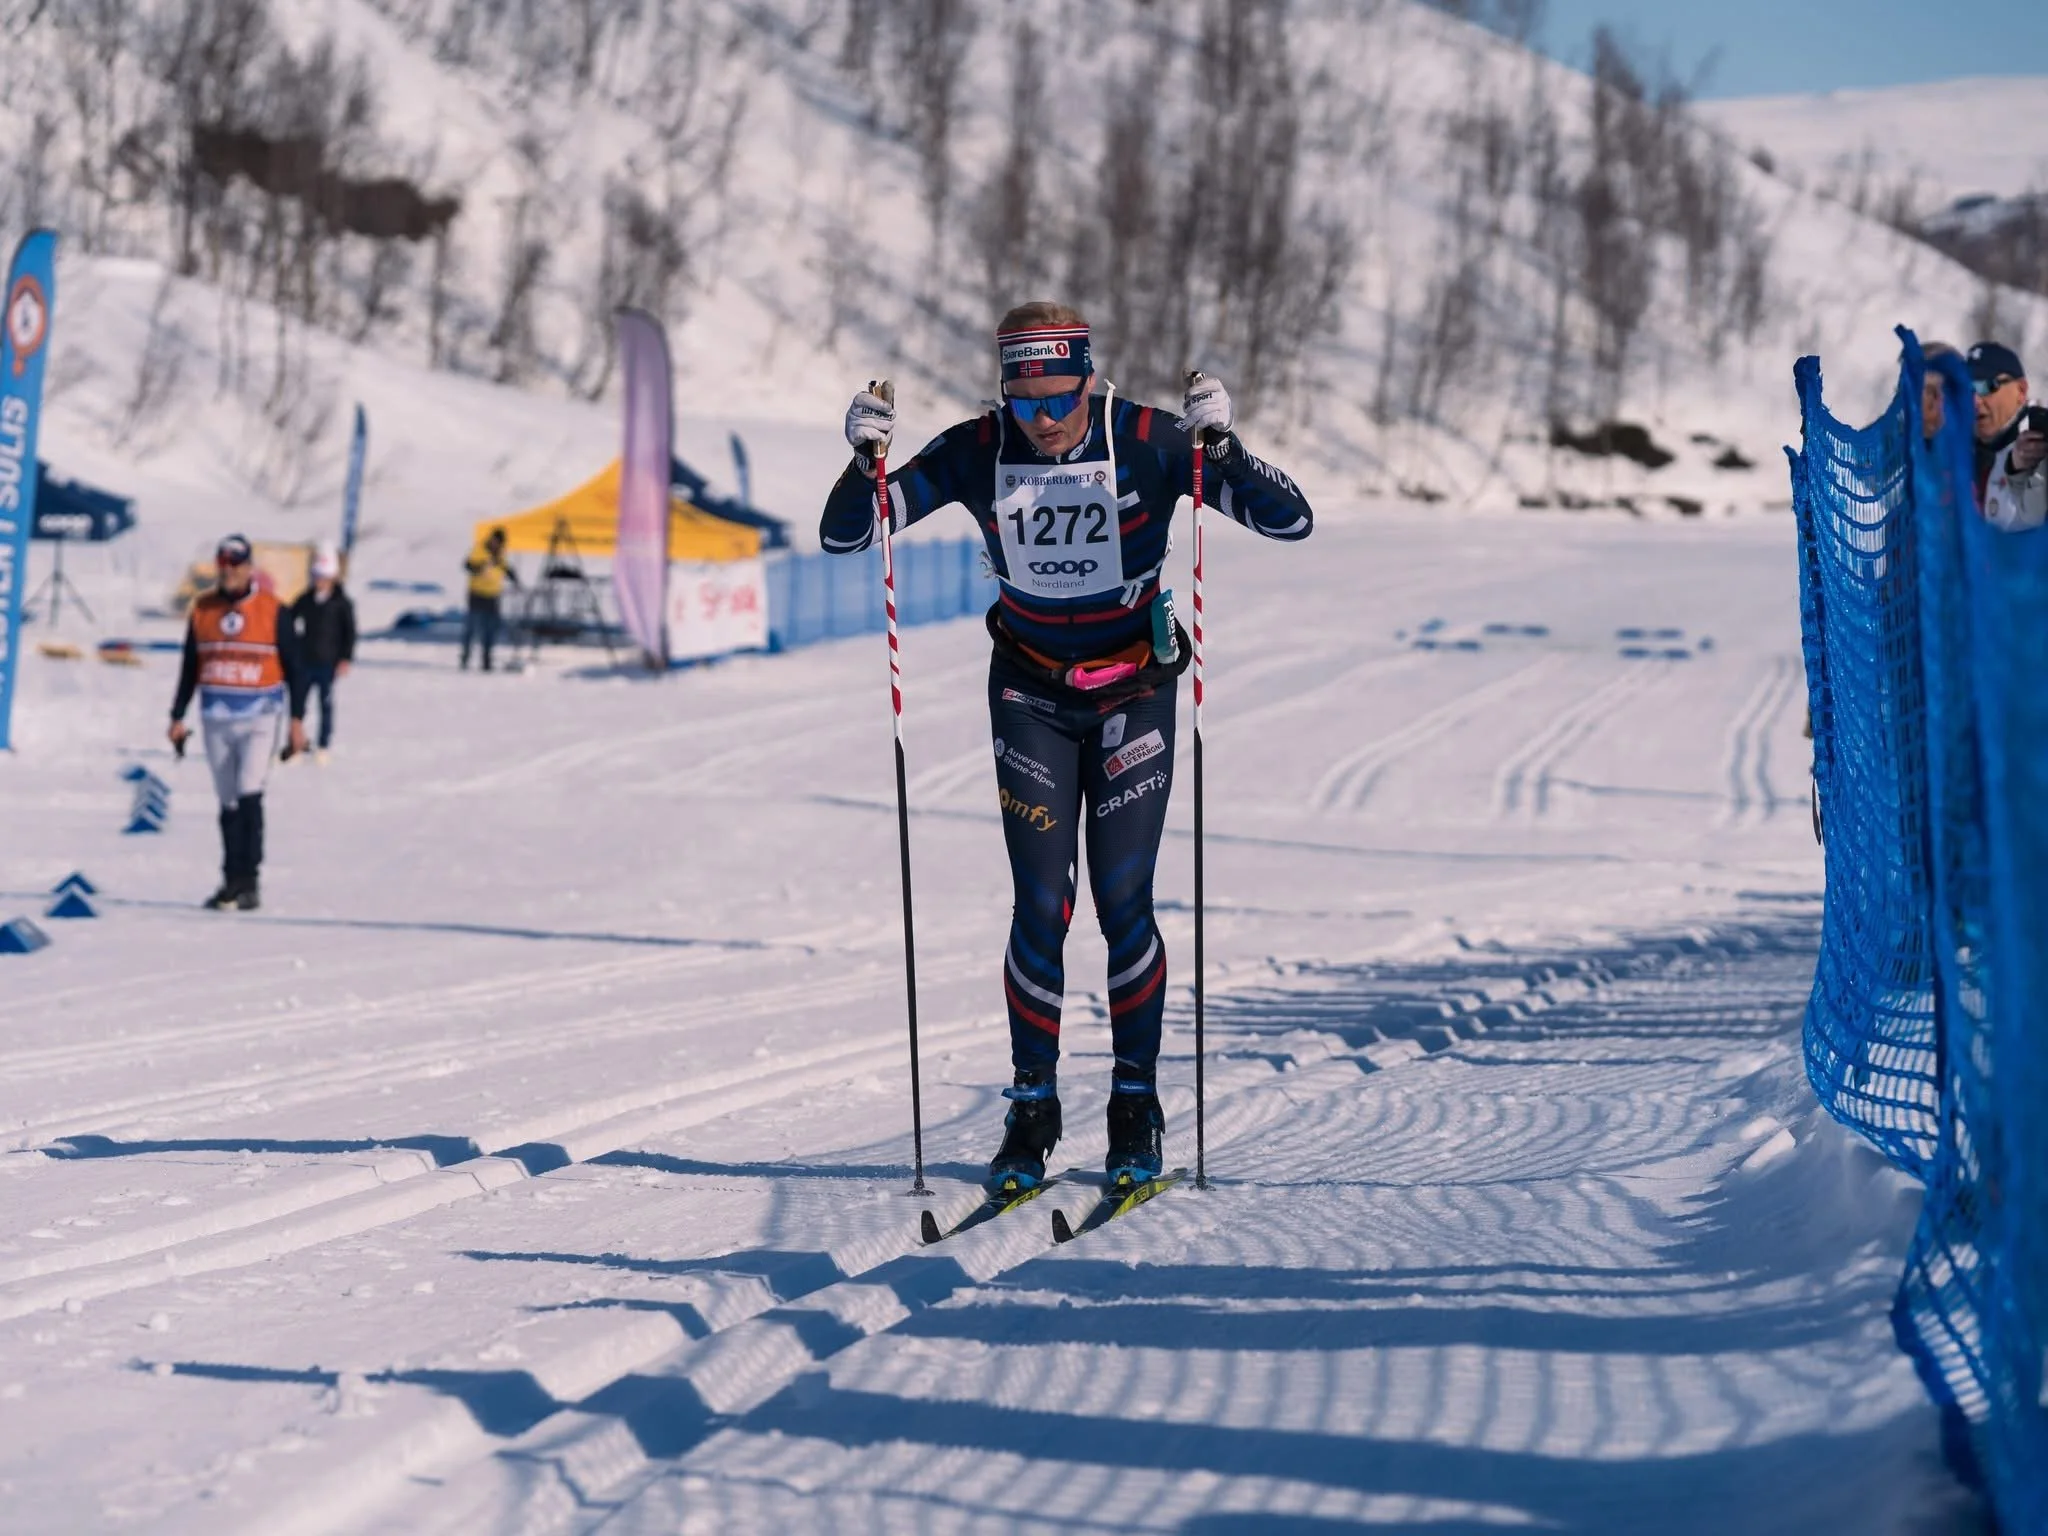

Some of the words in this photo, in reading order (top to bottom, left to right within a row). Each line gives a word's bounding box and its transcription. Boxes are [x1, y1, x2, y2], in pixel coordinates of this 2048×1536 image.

[1003, 345, 1054, 361] SpareBank
[1019, 473, 1092, 486] KOBBERLØPET
[1008, 502, 1109, 546] 1272
[1028, 558, 1099, 577] coop
[1032, 578, 1085, 588] Nordland
[1006, 747, 1051, 774] Auvergne-
[1121, 742, 1149, 760] CAISSE
[1125, 742, 1164, 766] D'EPARGNE
[1003, 755, 1056, 789] Rhône-Alpes
[1096, 776, 1157, 818] CRAFT
